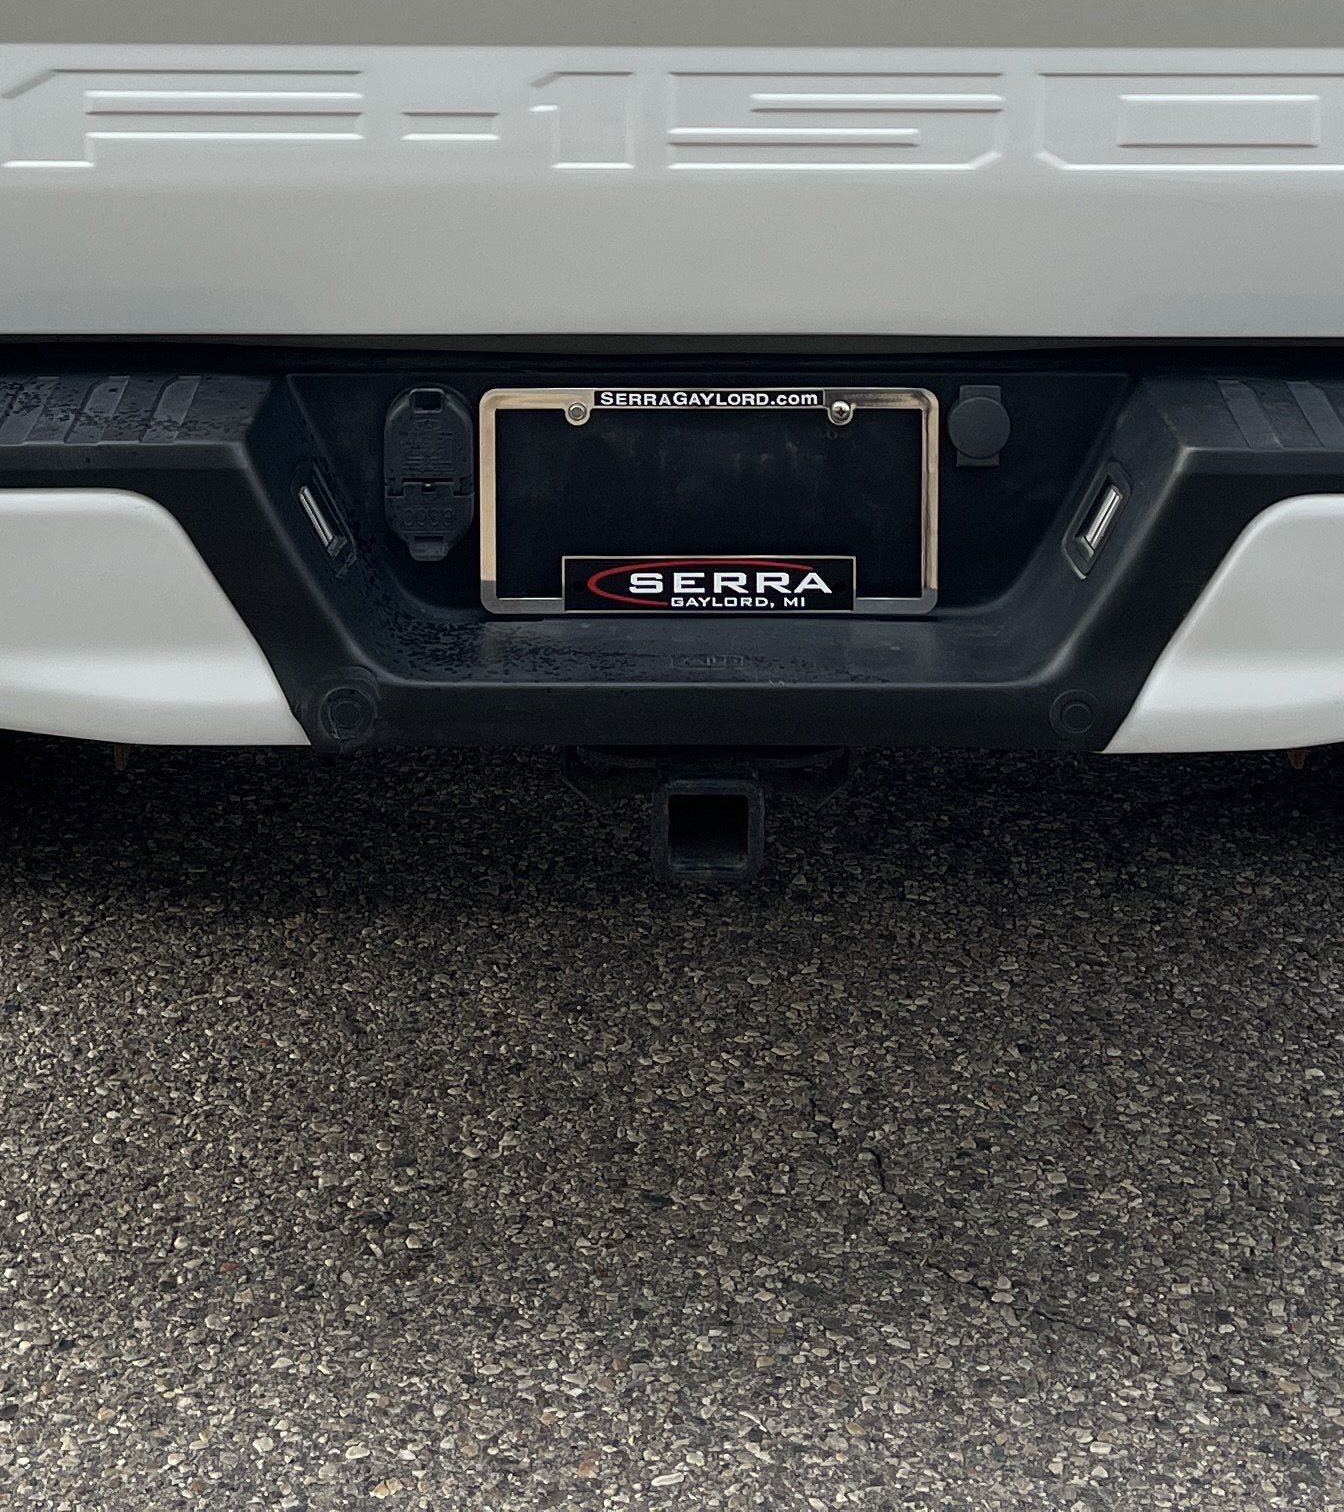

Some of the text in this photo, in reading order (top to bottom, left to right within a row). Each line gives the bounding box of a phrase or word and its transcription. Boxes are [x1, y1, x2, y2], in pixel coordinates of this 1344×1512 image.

[600, 391, 818, 407] SERRAGAYLORD.com
[628, 571, 833, 594] SERRA
[670, 596, 806, 609] GAYLORD, MI
